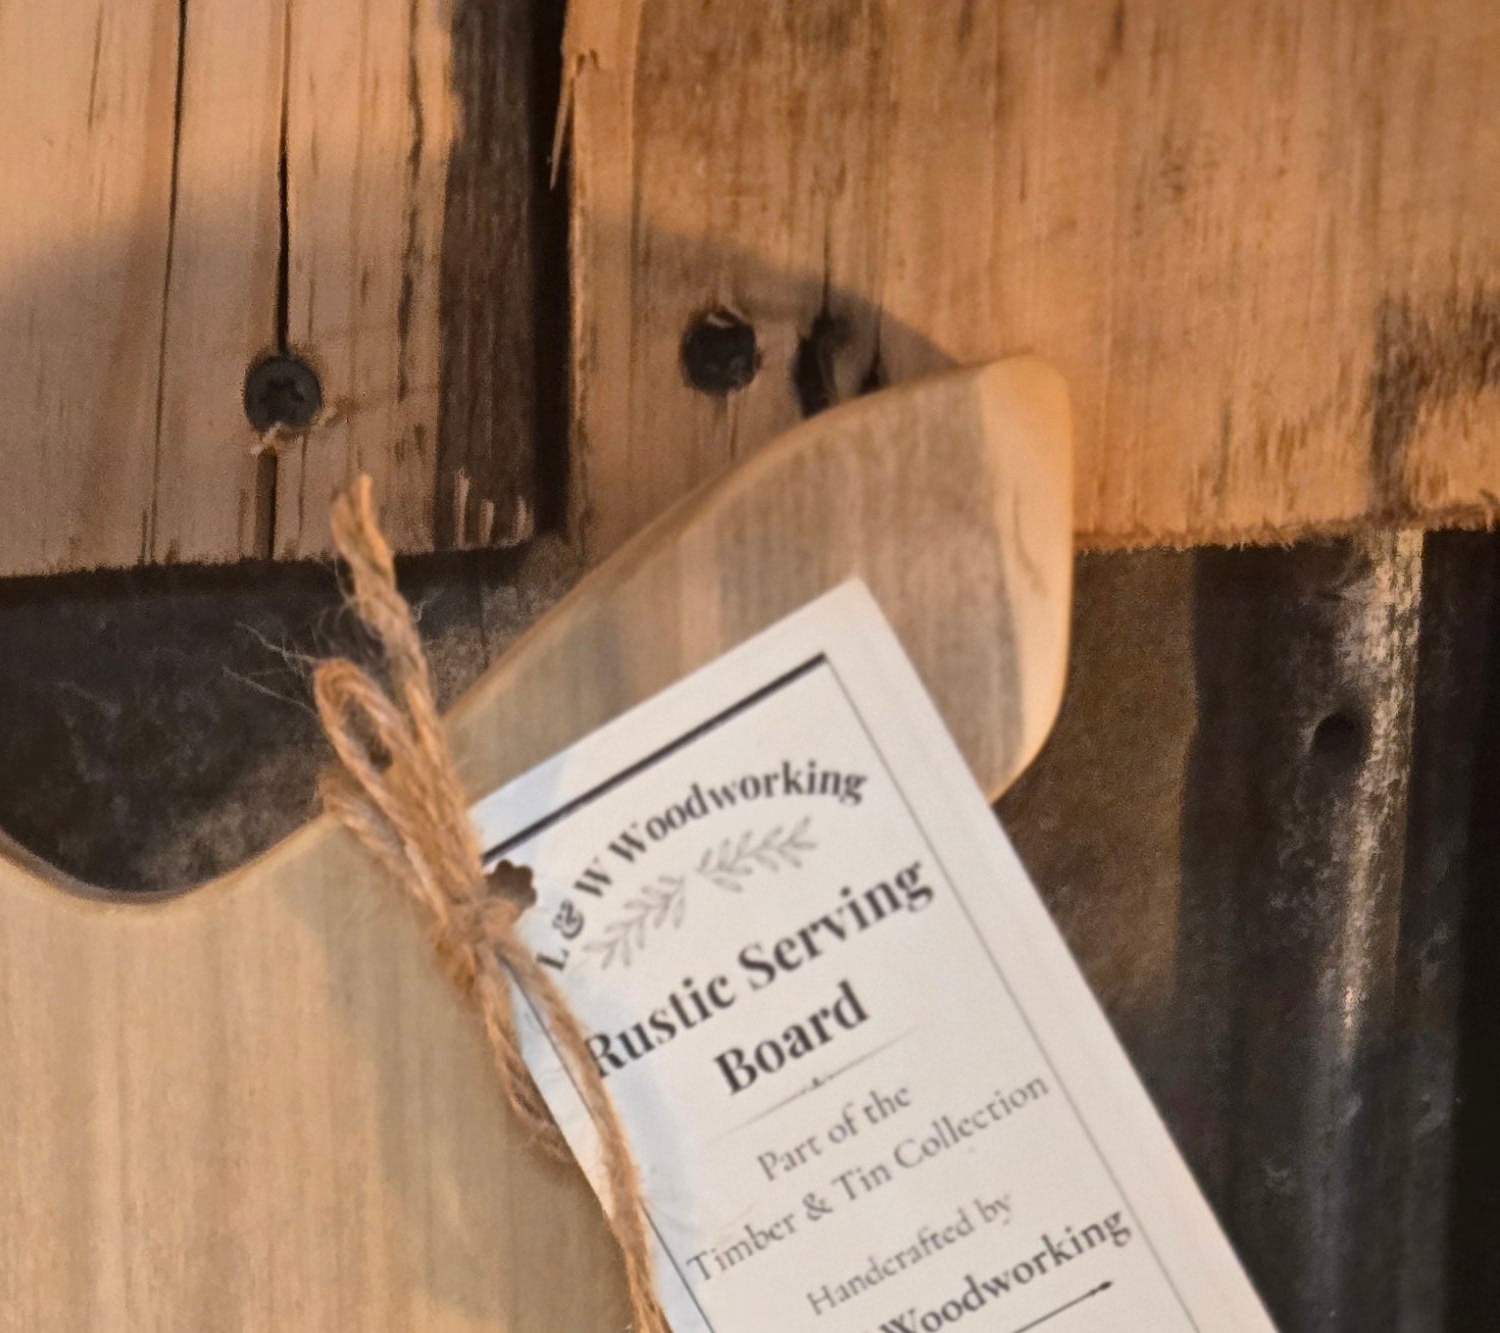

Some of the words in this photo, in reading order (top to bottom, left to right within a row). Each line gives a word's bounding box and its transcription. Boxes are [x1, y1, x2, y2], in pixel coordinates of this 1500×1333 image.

[607, 759, 869, 865] Woodworking
[552, 900, 586, 941] &
[573, 857, 613, 900] W
[536, 948, 571, 972] L
[584, 977, 736, 1079] Rustic
[738, 859, 936, 992] Serving
[713, 978, 871, 1096] Board
[685, 1212, 796, 1283] Timber
[801, 1190, 834, 1222] &
[832, 1162, 893, 1204] Tin
[893, 1076, 1051, 1170] Collection
[756, 1140, 823, 1182] Part
[827, 1102, 861, 1146] of
[863, 1083, 912, 1127] the
[805, 1199, 977, 1316] Handcrafted
[977, 1191, 1016, 1227] by
